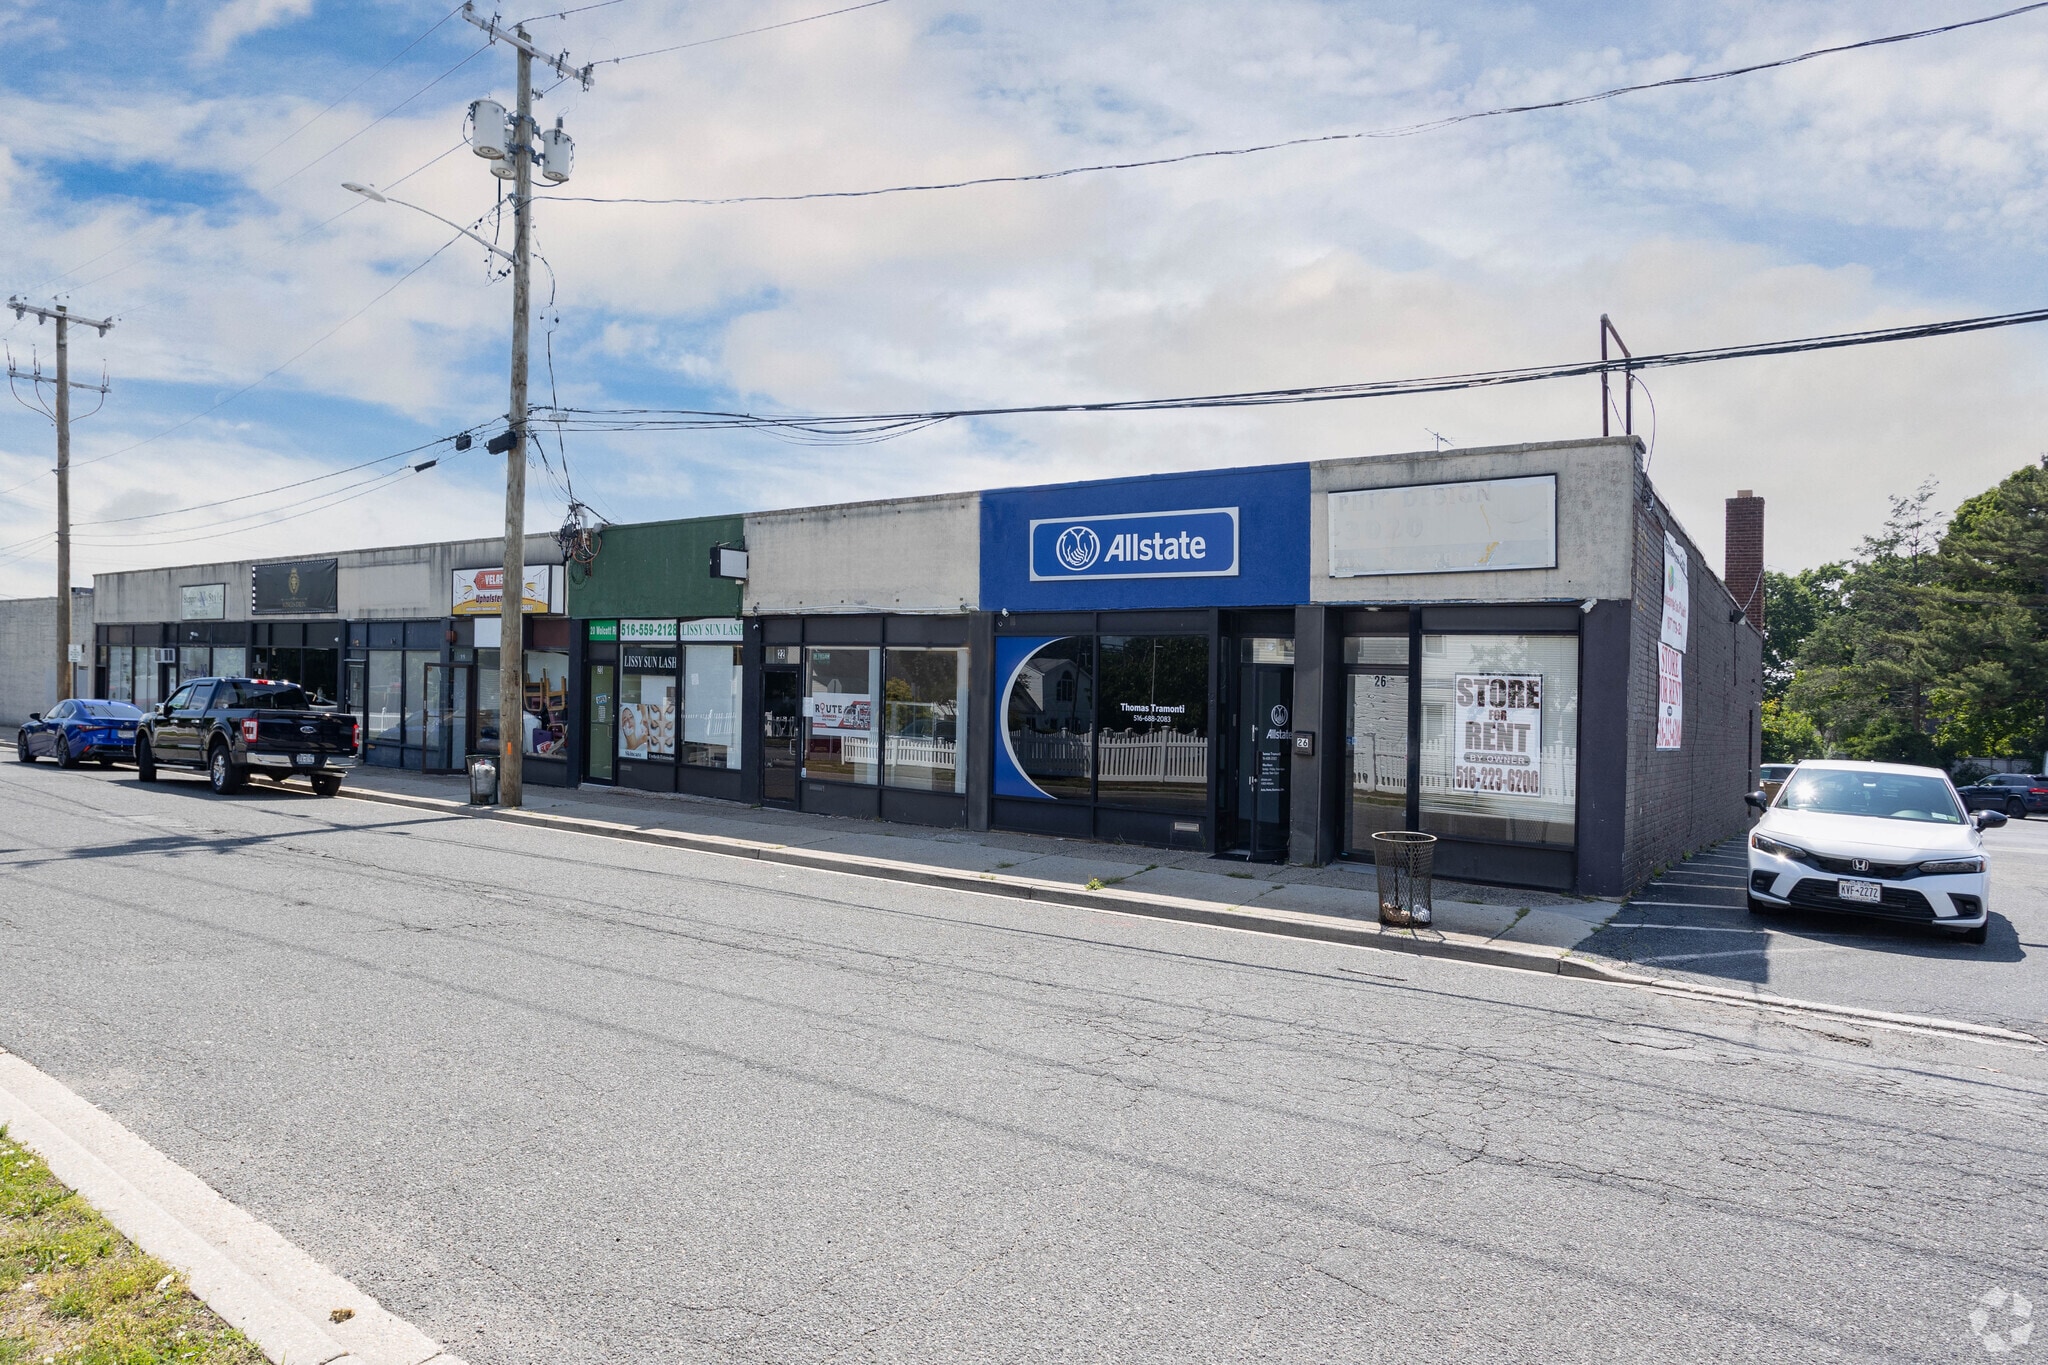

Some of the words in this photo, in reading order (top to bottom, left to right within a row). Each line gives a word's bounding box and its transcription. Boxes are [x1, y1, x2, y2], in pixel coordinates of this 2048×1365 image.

[1104, 531, 1206, 562] Allstate
[484, 574, 503, 585] VELAS
[475, 594, 503, 605] Upholster
[621, 623, 677, 636] 516-559-2128
[681, 624, 704, 636] LISSY
[706, 624, 720, 635] SUN
[722, 624, 744, 635] LASH
[624, 655, 643, 667] LISSY
[643, 656, 657, 668] SUN
[658, 656, 677, 669] LASH
[1374, 675, 1386, 687] 26
[1457, 678, 1540, 709] STORE
[1120, 703, 1149, 712] Thomas
[1150, 704, 1185, 713] Tramonti
[1133, 715, 1172, 723] 516-688-2083
[1489, 710, 1507, 721] FOR
[1266, 728, 1293, 740] Allstate
[1465, 721, 1531, 752] RENT
[1297, 738, 1308, 747] 26
[1486, 755, 1526, 765] OWNER
[1456, 765, 1539, 793] 516-223-6200
